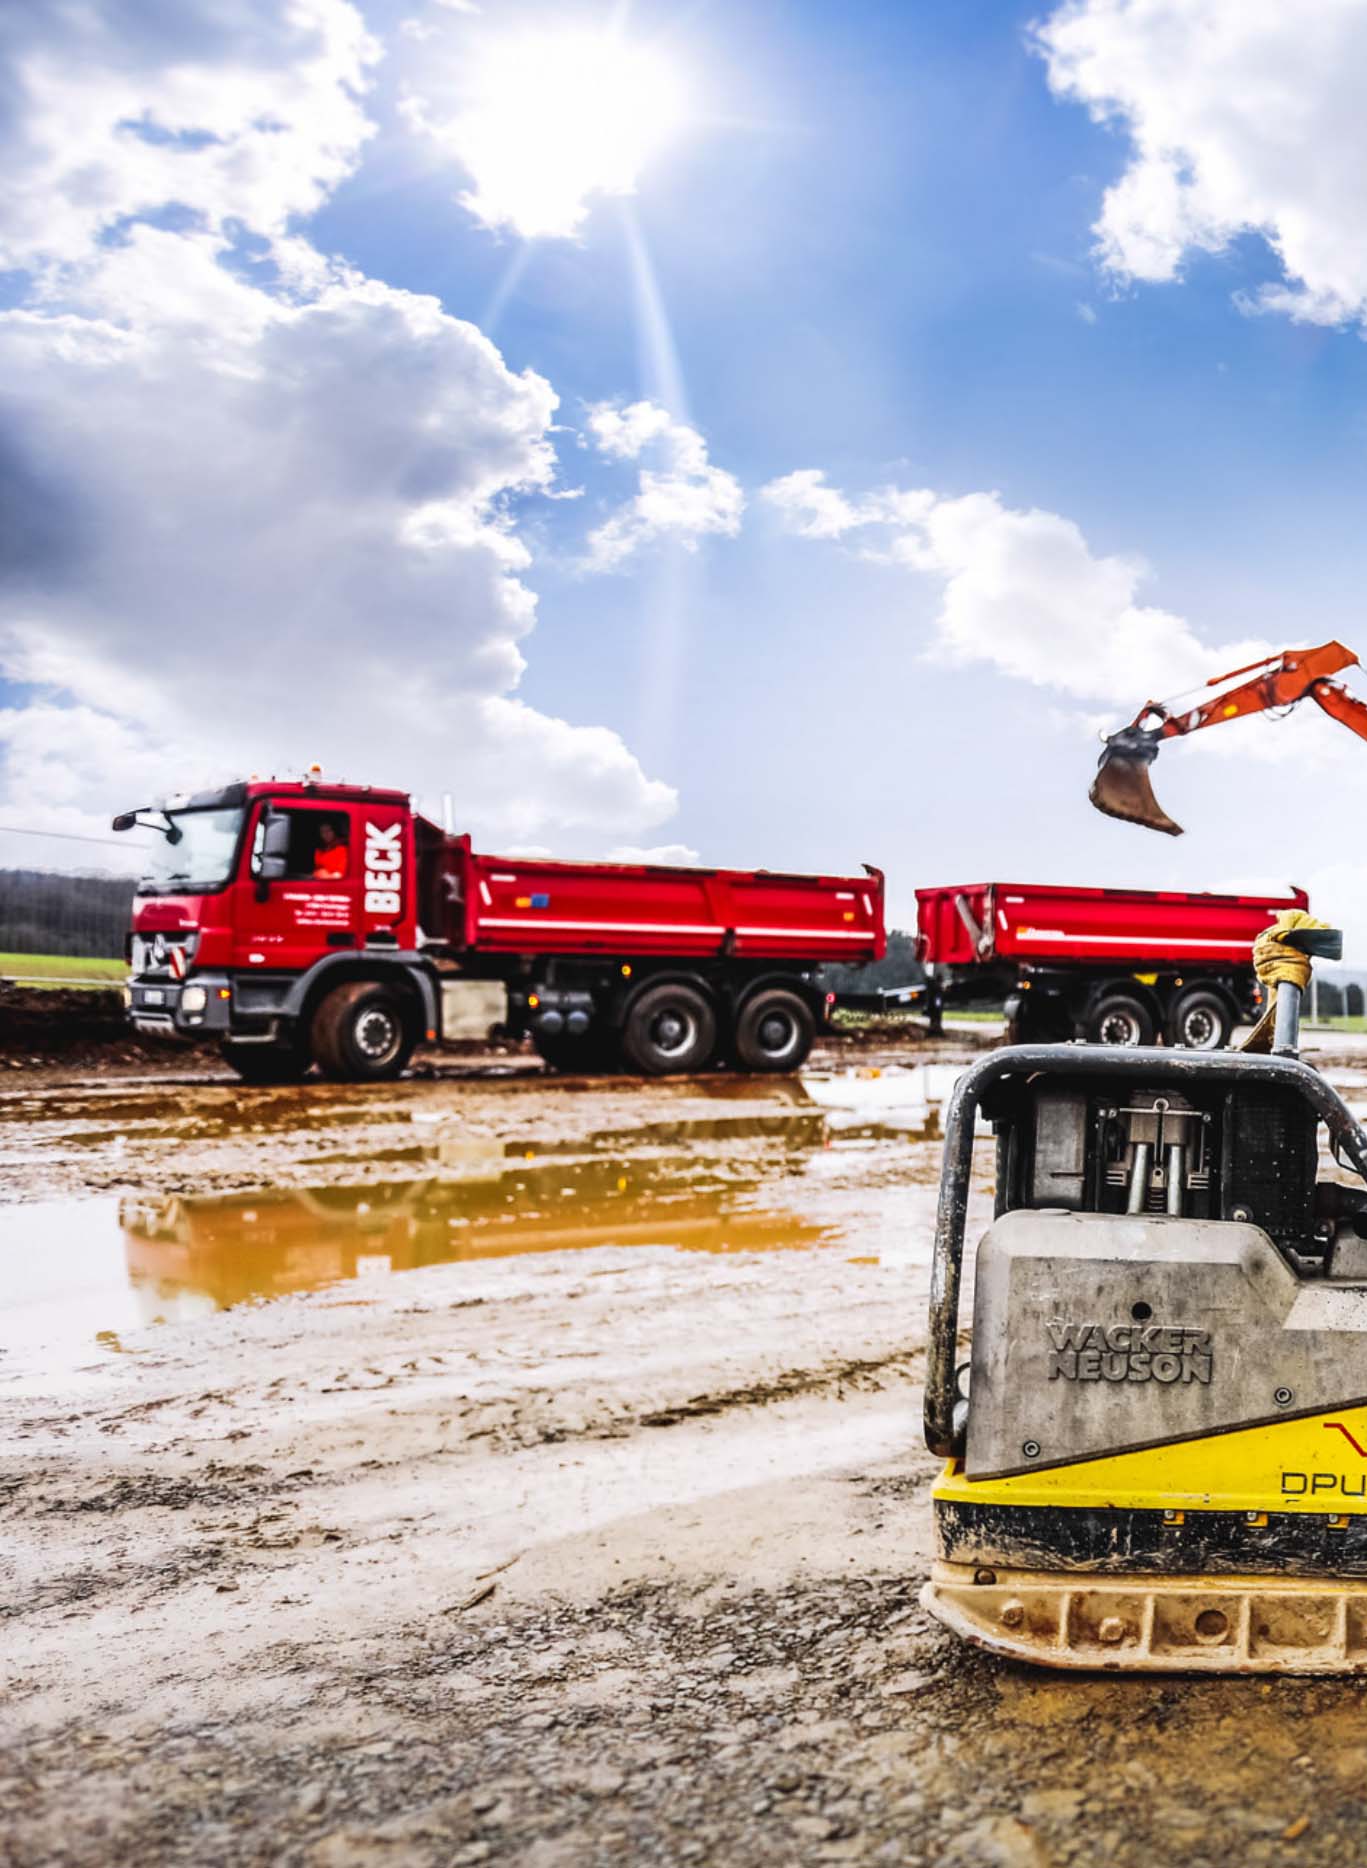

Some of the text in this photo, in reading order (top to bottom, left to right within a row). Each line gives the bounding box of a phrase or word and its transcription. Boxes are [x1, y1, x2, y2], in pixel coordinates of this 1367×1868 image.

[364, 821, 402, 914] BECK
[1046, 1323, 1213, 1355] WACKER
[1048, 1351, 1213, 1384] NEUSON
